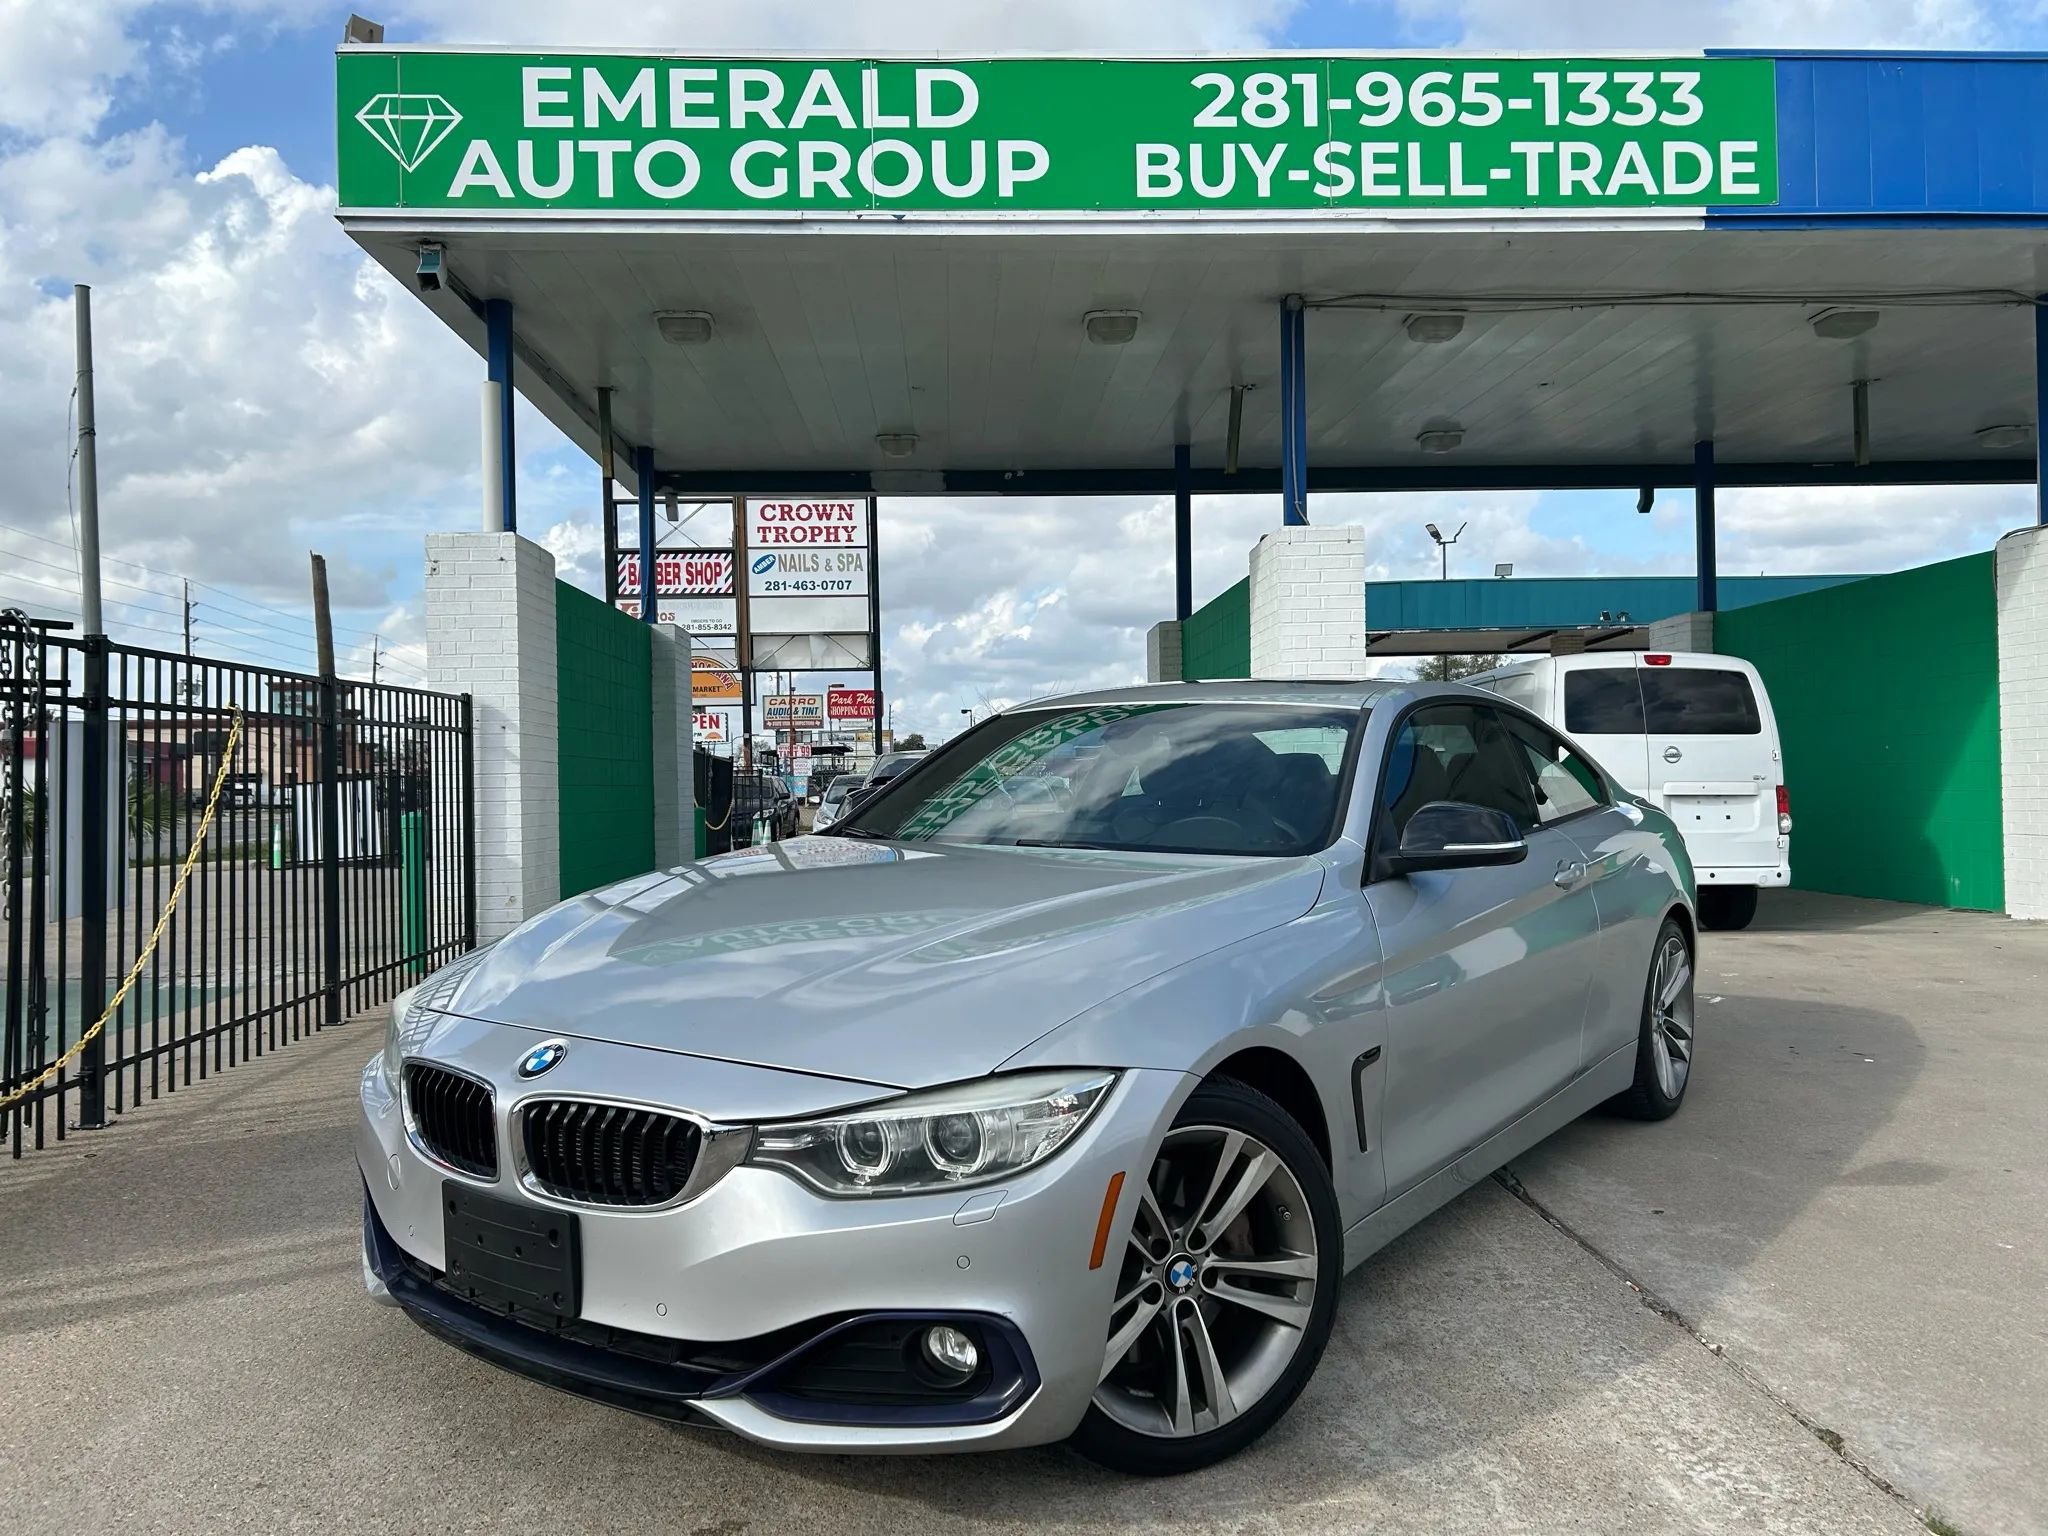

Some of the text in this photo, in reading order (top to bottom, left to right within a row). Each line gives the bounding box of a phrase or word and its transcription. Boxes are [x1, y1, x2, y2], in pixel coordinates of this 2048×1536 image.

[522, 67, 979, 129] EMERALD
[1190, 71, 1704, 128] 281-965-1333
[447, 139, 1050, 199] AUTO GROUP
[1134, 140, 1760, 198] BUY-SELL-TRADE
[760, 503, 855, 521] CROWN
[757, 526, 857, 543] TROPHY
[753, 555, 776, 574] AMBER
[778, 553, 864, 572] NAILS & SPA
[628, 561, 723, 586] BBER SHOP
[765, 580, 852, 591] 281-463-0707
[769, 698, 817, 706] CARRO
[830, 693, 854, 705] Park
[767, 706, 819, 716] AUDIO & TINT
[860, 705, 876, 716] CENT
[692, 715, 720, 729] PEN
